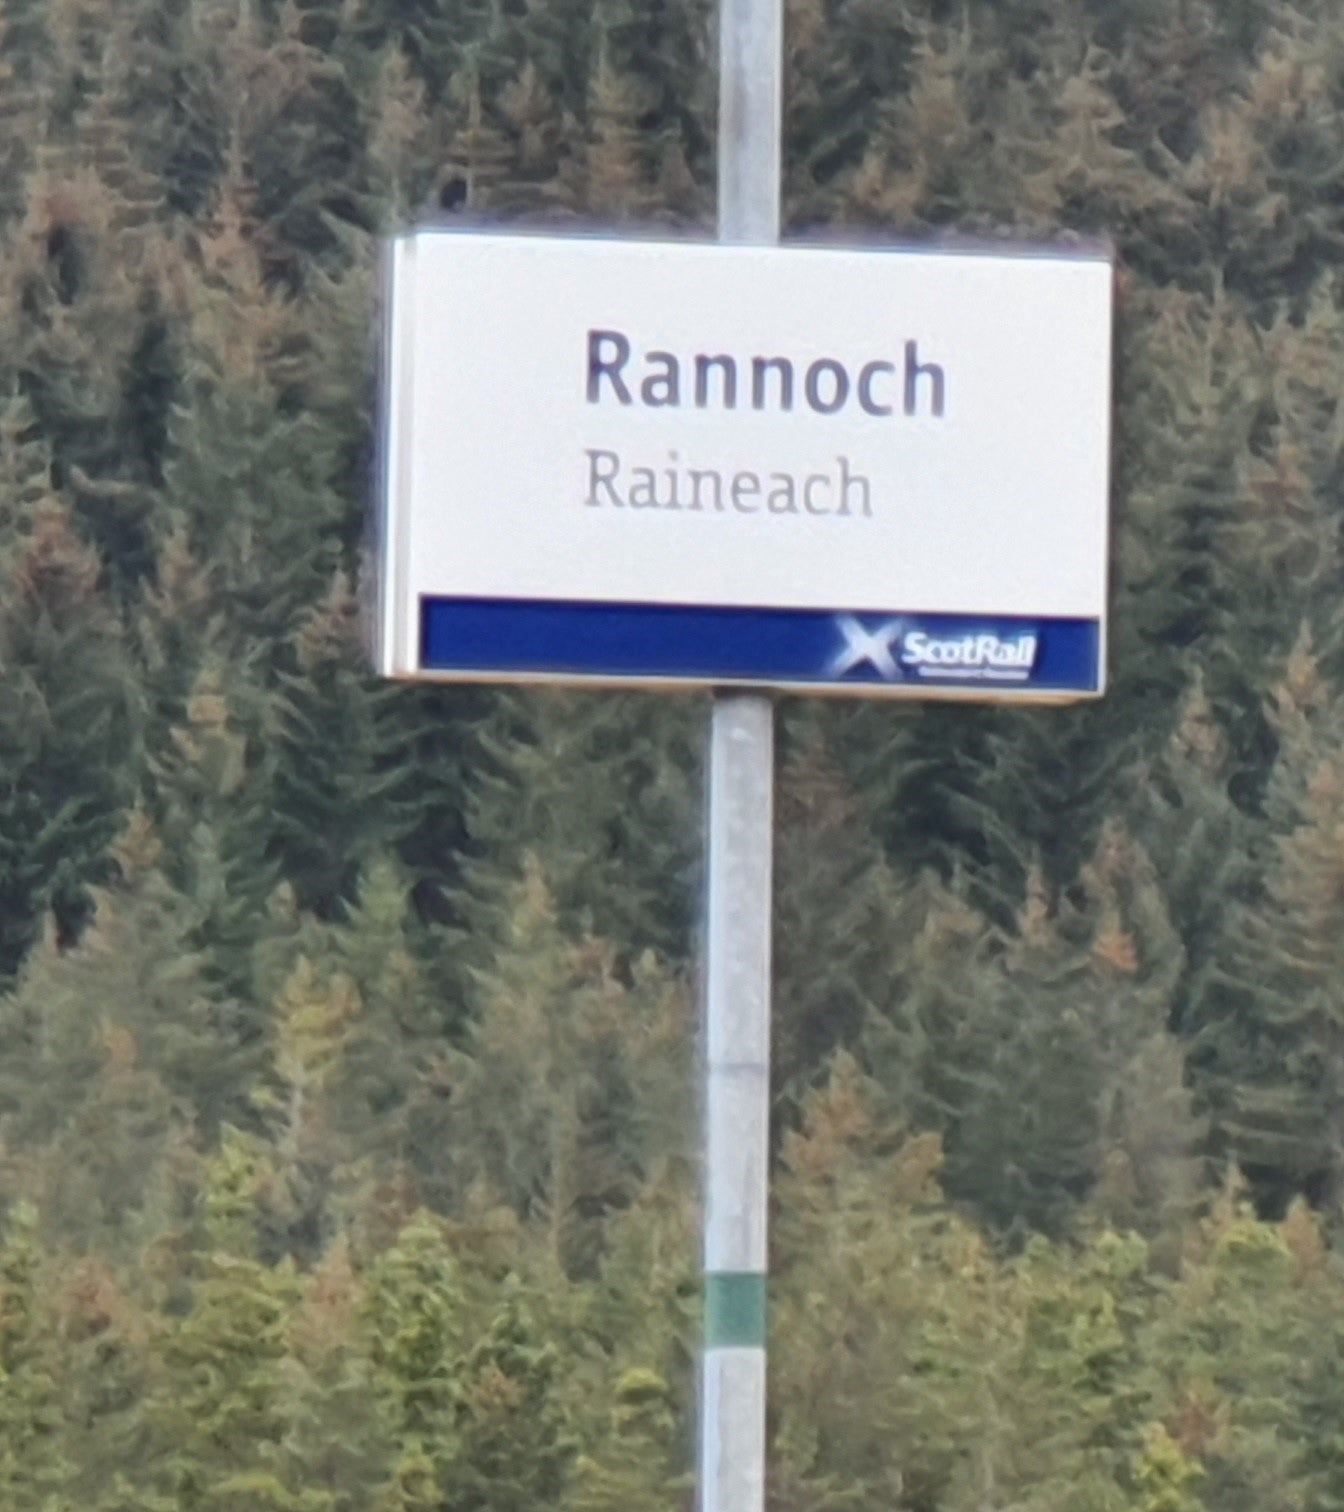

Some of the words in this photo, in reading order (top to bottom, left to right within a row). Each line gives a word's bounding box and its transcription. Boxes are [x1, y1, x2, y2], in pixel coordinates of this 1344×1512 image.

[587, 329, 946, 417] Rannoch
[584, 449, 873, 517] Raineach
[901, 631, 1036, 666] ScotRail
